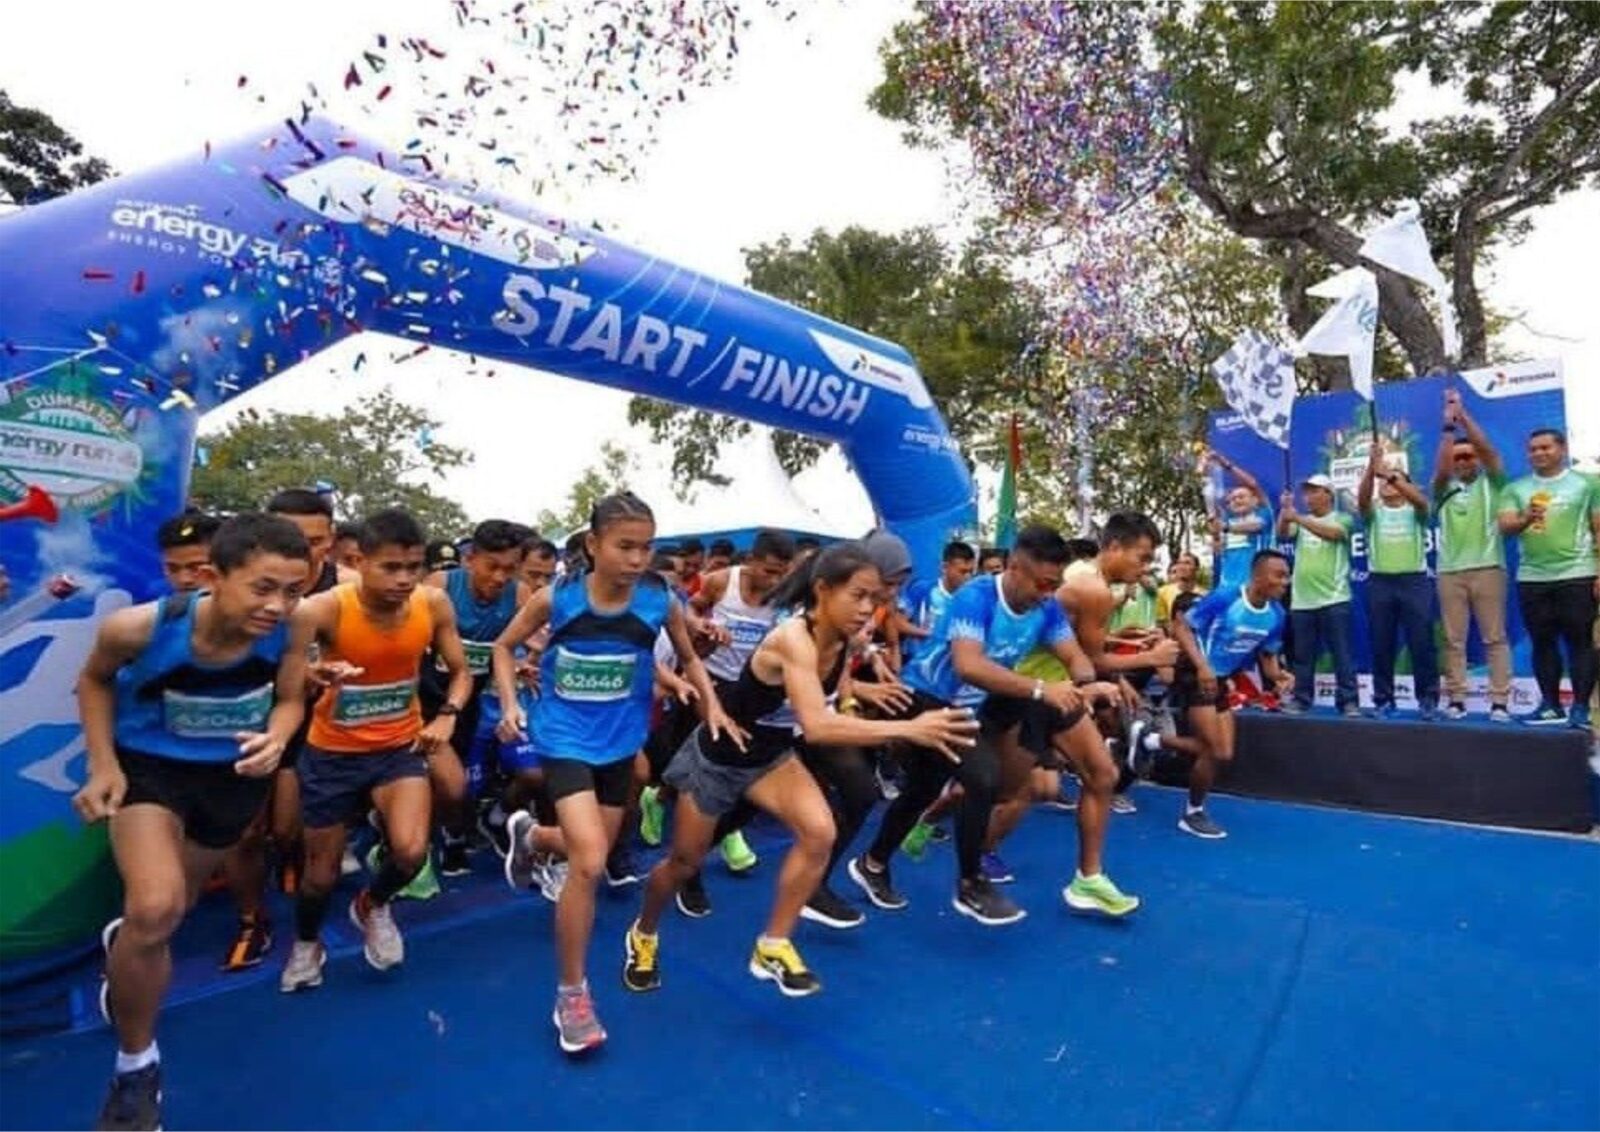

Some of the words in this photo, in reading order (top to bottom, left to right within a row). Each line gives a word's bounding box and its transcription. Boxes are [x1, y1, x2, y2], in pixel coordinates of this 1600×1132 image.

[112, 207, 248, 257] energy
[491, 272, 708, 379] START
[720, 344, 872, 425] FINISH
